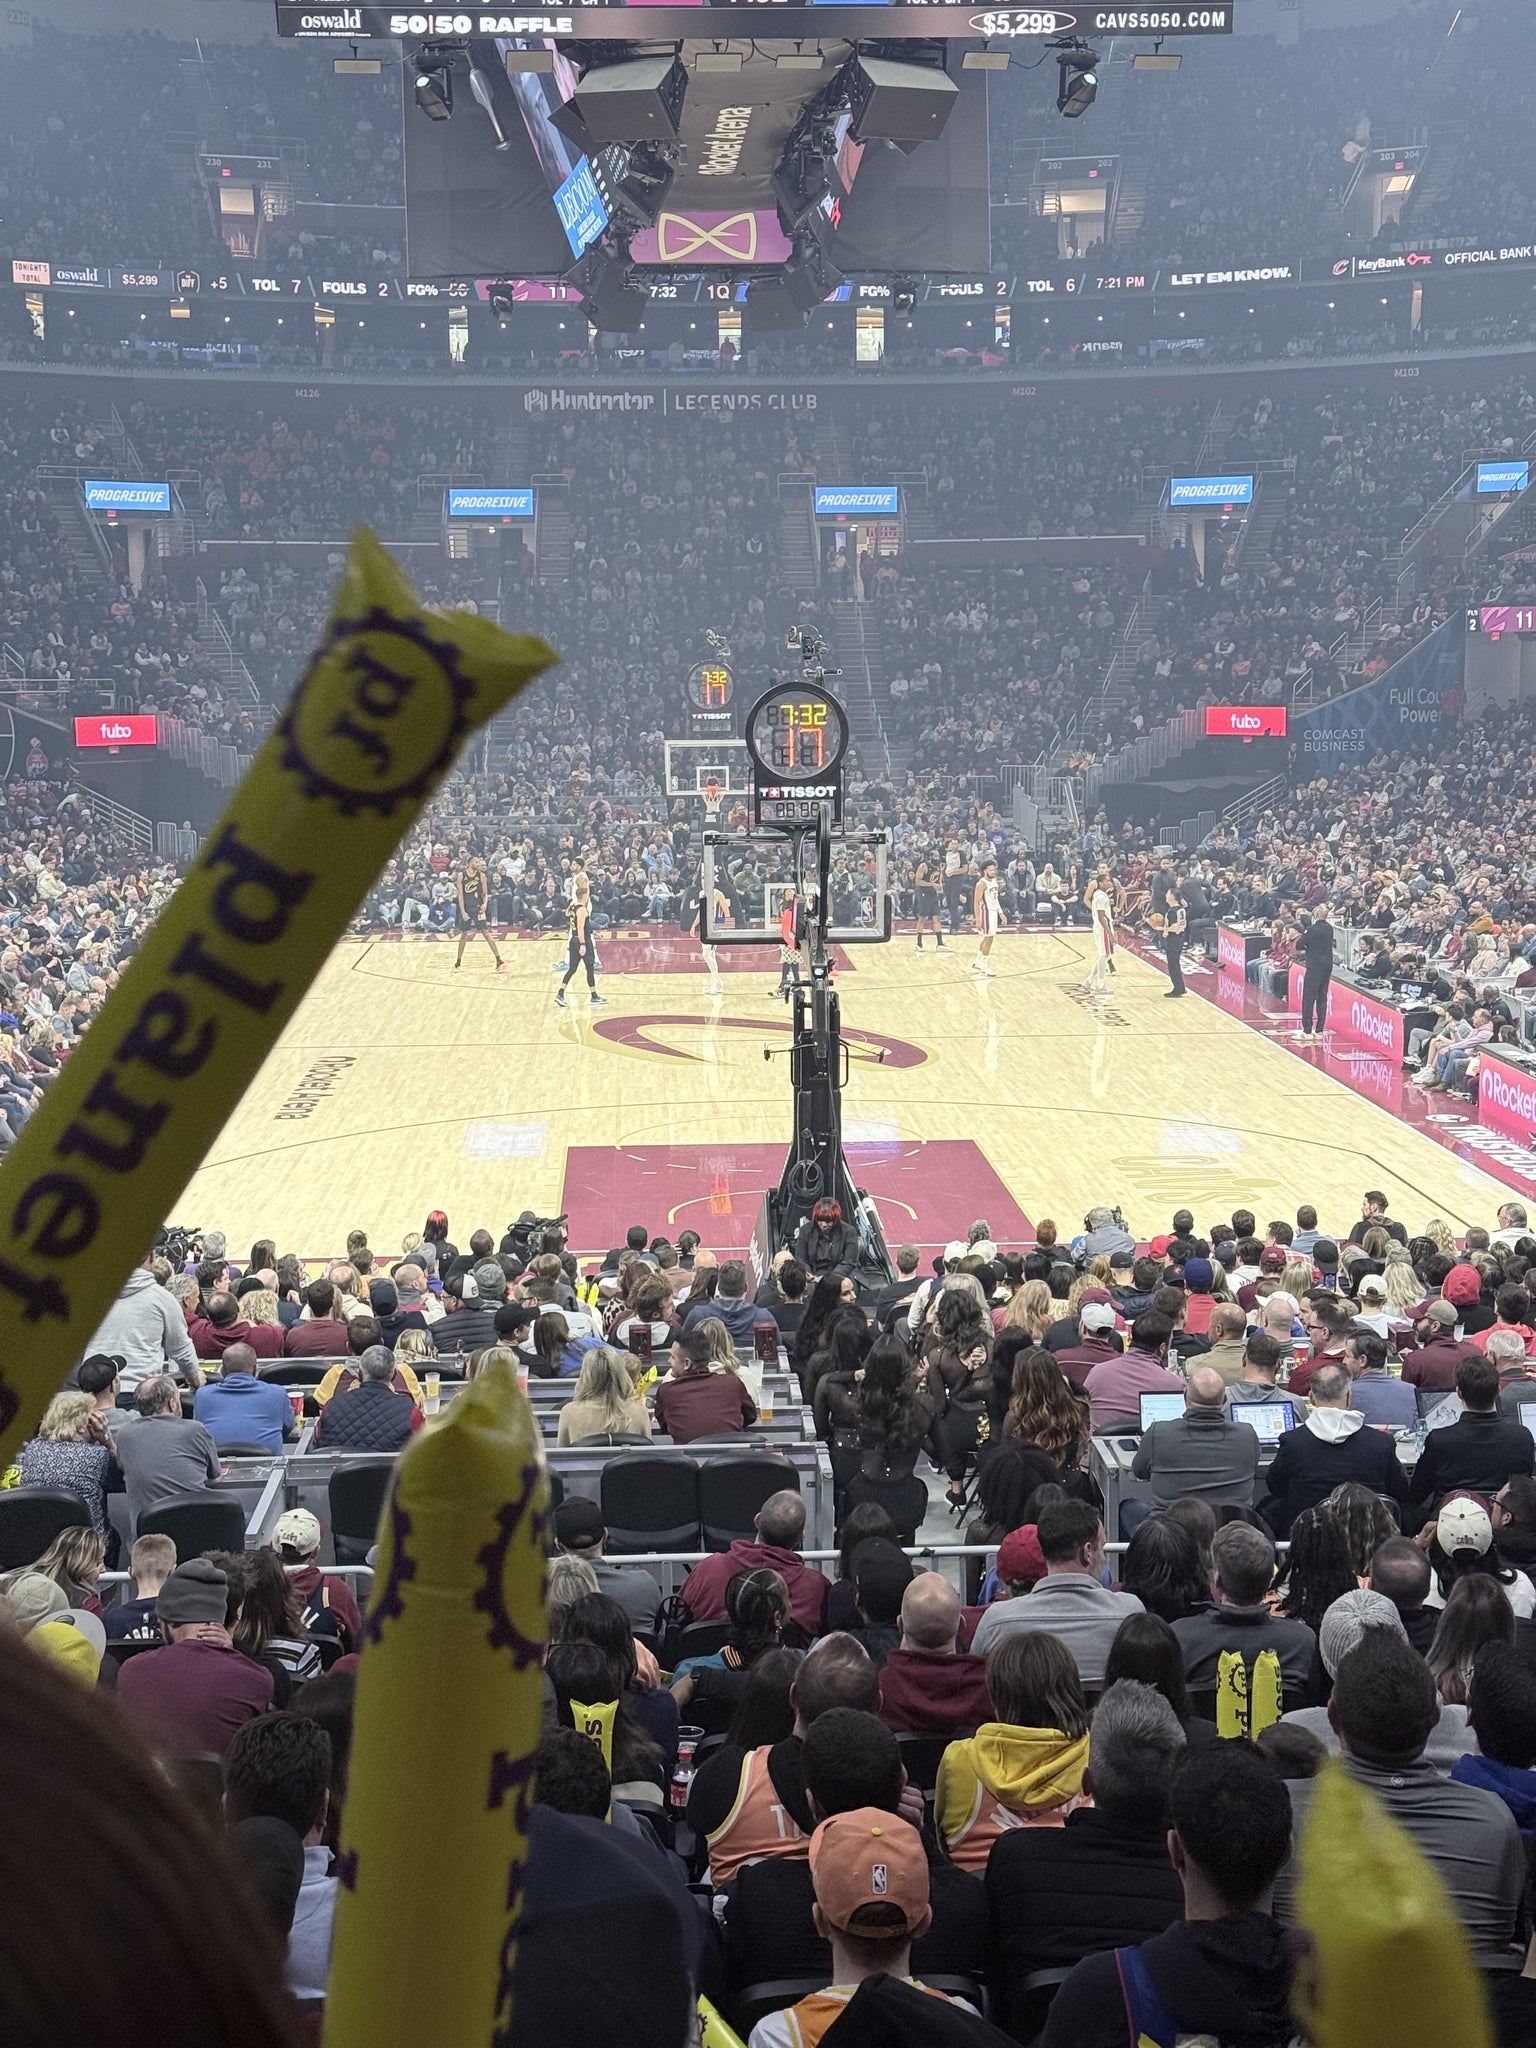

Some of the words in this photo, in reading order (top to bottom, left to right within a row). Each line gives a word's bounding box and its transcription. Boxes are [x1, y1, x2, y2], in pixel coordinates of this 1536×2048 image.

[300, 9, 362, 29] oswald
[479, 16, 573, 33] RAFFLE
[982, 13, 1057, 37] $5,299
[1095, 11, 1225, 28] CAVS5050.COM
[704, 106, 753, 140] Arena
[698, 139, 744, 170] Rocket
[1444, 250, 1498, 265] OFFICIAL
[1499, 245, 1532, 260] BANK
[14, 262, 49, 273] TONIGHT'S
[1358, 256, 1406, 271] KeyBank
[22, 273, 41, 284] TOTAL
[56, 268, 99, 283] oswald
[121, 273, 159, 287] $5,299
[210, 276, 228, 290] +5
[1096, 277, 1121, 290] 7:21
[1126, 276, 1145, 288] PM
[1171, 272, 1206, 286] LET
[1206, 271, 1237, 284] EM
[1238, 267, 1292, 282] KNOW.
[252, 279, 281, 292] TOL
[291, 279, 302, 294] 7
[322, 281, 368, 295] FOULS
[378, 282, 389, 297] 2
[406, 283, 439, 297] FG%
[548, 285, 568, 299] 11
[649, 285, 678, 298] 7:32
[707, 285, 730, 300] 1Q
[859, 284, 891, 298] FG%
[940, 283, 984, 296] FOULS
[996, 281, 1007, 296] 2
[1027, 279, 1055, 293] TOL
[1065, 278, 1076, 292] 6
[88, 488, 166, 503] PROGRESSIVE
[1173, 483, 1249, 498] PROGRESSIVE
[452, 496, 529, 508] PROGRESSIVE
[817, 493, 894, 506] PROGRESSIVE
[1469, 618, 1477, 631] 2
[1515, 610, 1533, 629] 11
[701, 671, 728, 684] 7:32
[1389, 687, 1415, 705] Full
[1417, 688, 1441, 705] Cou
[702, 712, 732, 720] TISSOT
[779, 703, 829, 726] 7:32
[1230, 713, 1261, 729] fubo
[100, 723, 133, 739] fubo
[1303, 728, 1367, 740] COMCAST
[1303, 740, 1366, 752] BUSINESS
[780, 785, 837, 798] TISSOT
[1225, 938, 1246, 969] Rocket
[1360, 1006, 1395, 1049] Rocket
